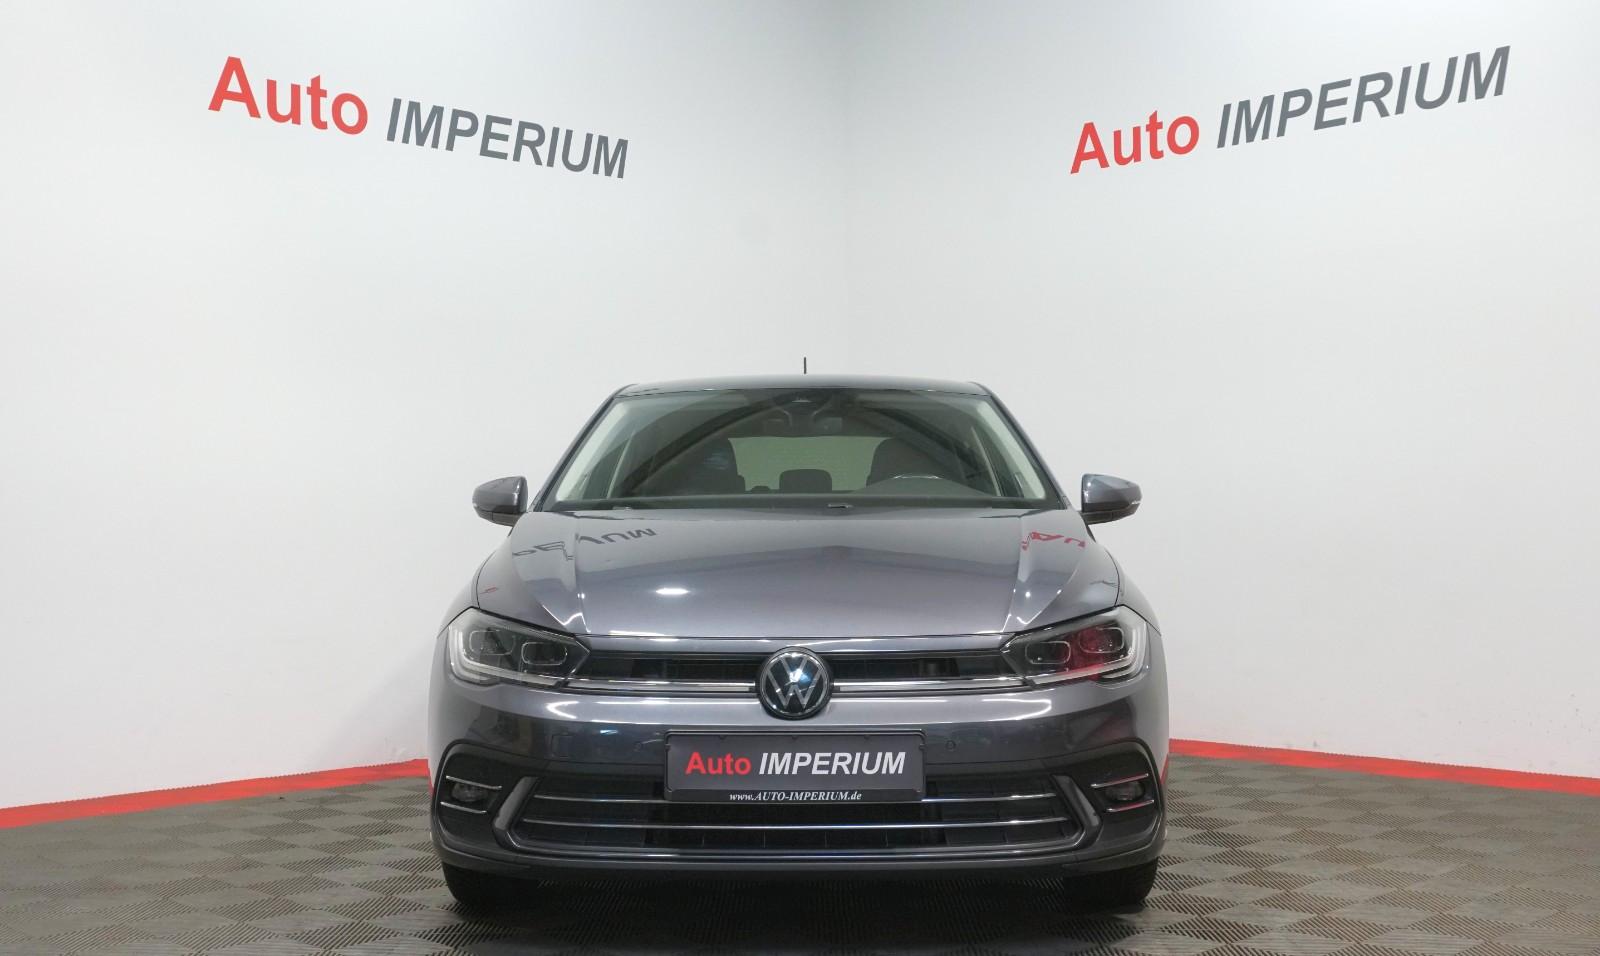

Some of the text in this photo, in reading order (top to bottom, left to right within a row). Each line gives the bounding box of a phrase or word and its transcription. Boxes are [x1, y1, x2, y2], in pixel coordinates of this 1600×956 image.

[208, 56, 629, 179] Auto IMPERIUM
[1070, 45, 1511, 174] Auto IMPERIUM
[685, 751, 906, 776] Auto IMPERIUM
[729, 790, 862, 802] www.AUTO-IMPERIUM.de
